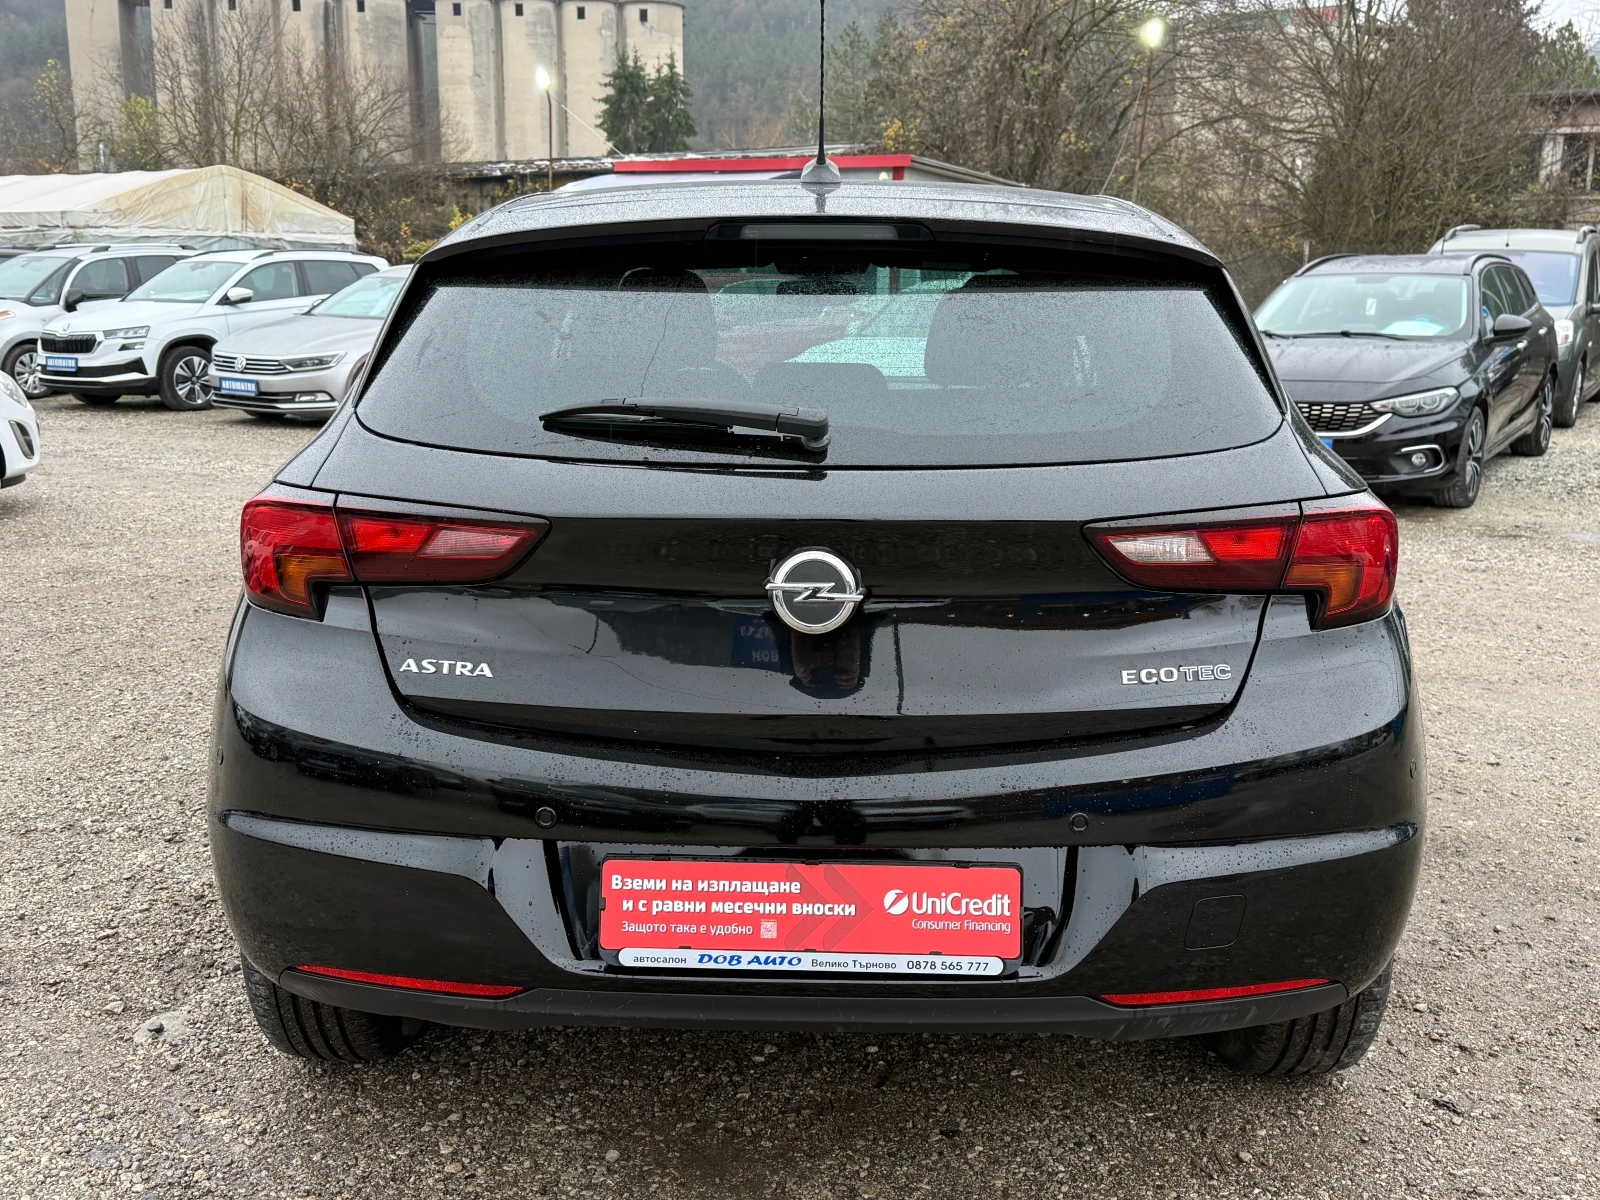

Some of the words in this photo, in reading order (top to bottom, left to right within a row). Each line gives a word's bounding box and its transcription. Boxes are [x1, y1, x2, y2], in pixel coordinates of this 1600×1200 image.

[399, 658, 494, 678] ASTRA
[1121, 664, 1232, 685] ECOTEC
[611, 875, 667, 891] Вземи
[671, 879, 692, 891] на
[697, 880, 801, 895] изплащане
[622, 900, 633, 911] и
[638, 901, 647, 911] с
[652, 900, 706, 915] равни
[711, 903, 786, 914] месечни
[792, 904, 856, 916] вноски
[912, 891, 1011, 917] UniCredit
[621, 921, 666, 935] Защото
[670, 923, 697, 934] така
[700, 925, 706, 934] е
[710, 923, 753, 936] удобно
[912, 919, 961, 930] Consumer
[964, 920, 1011, 934] Financing
[633, 955, 687, 964] автосалон
[811, 958, 849, 969] Велико
[852, 960, 897, 970] Търново
[906, 960, 937, 971] 0878
[940, 961, 963, 972] 565
[967, 962, 989, 972] 777
